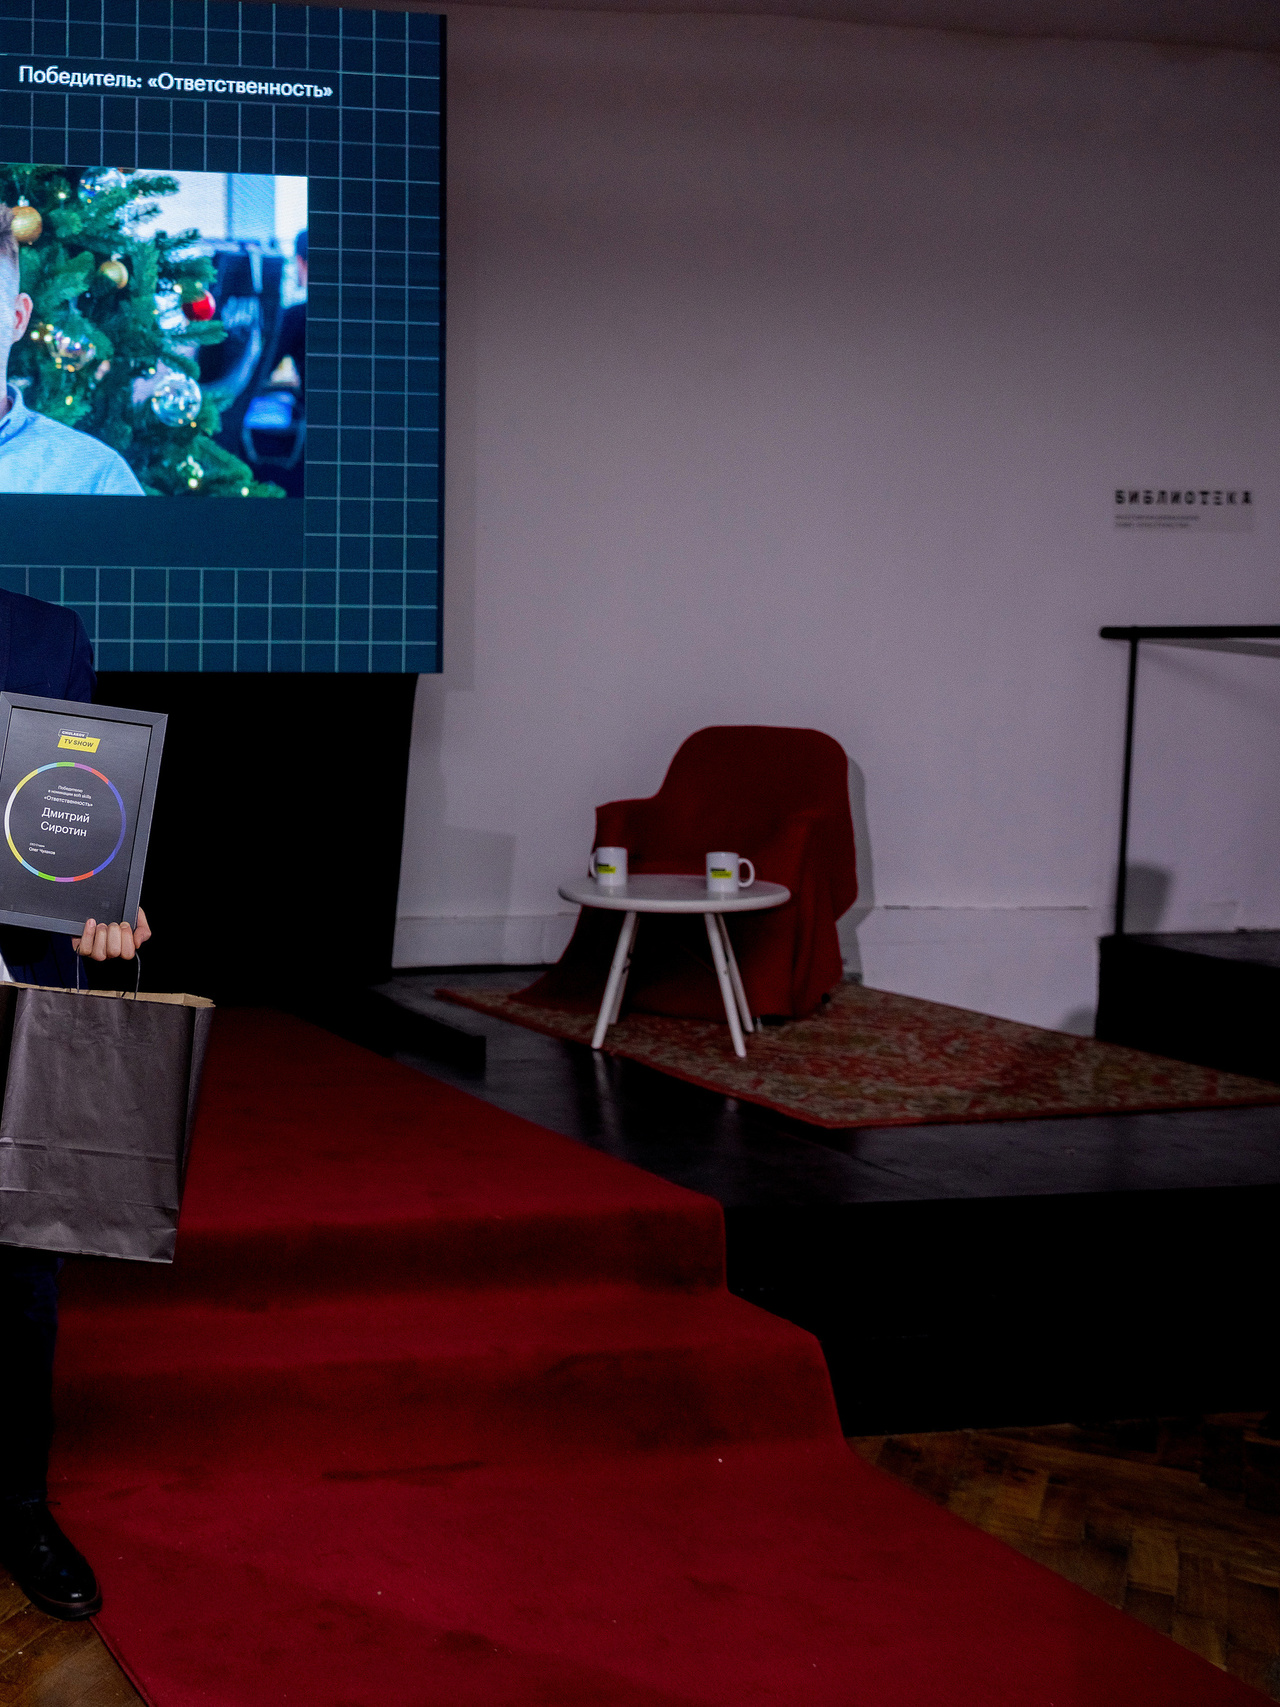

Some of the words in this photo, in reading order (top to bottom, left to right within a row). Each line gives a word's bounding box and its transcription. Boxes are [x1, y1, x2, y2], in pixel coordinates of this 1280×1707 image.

[18, 65, 143, 88] Победитель:
[147, 72, 334, 98] «Ответственность»
[73, 740, 94, 748] SHOW
[41, 807, 90, 824] Дмитрий
[40, 821, 87, 837] Сиротин
